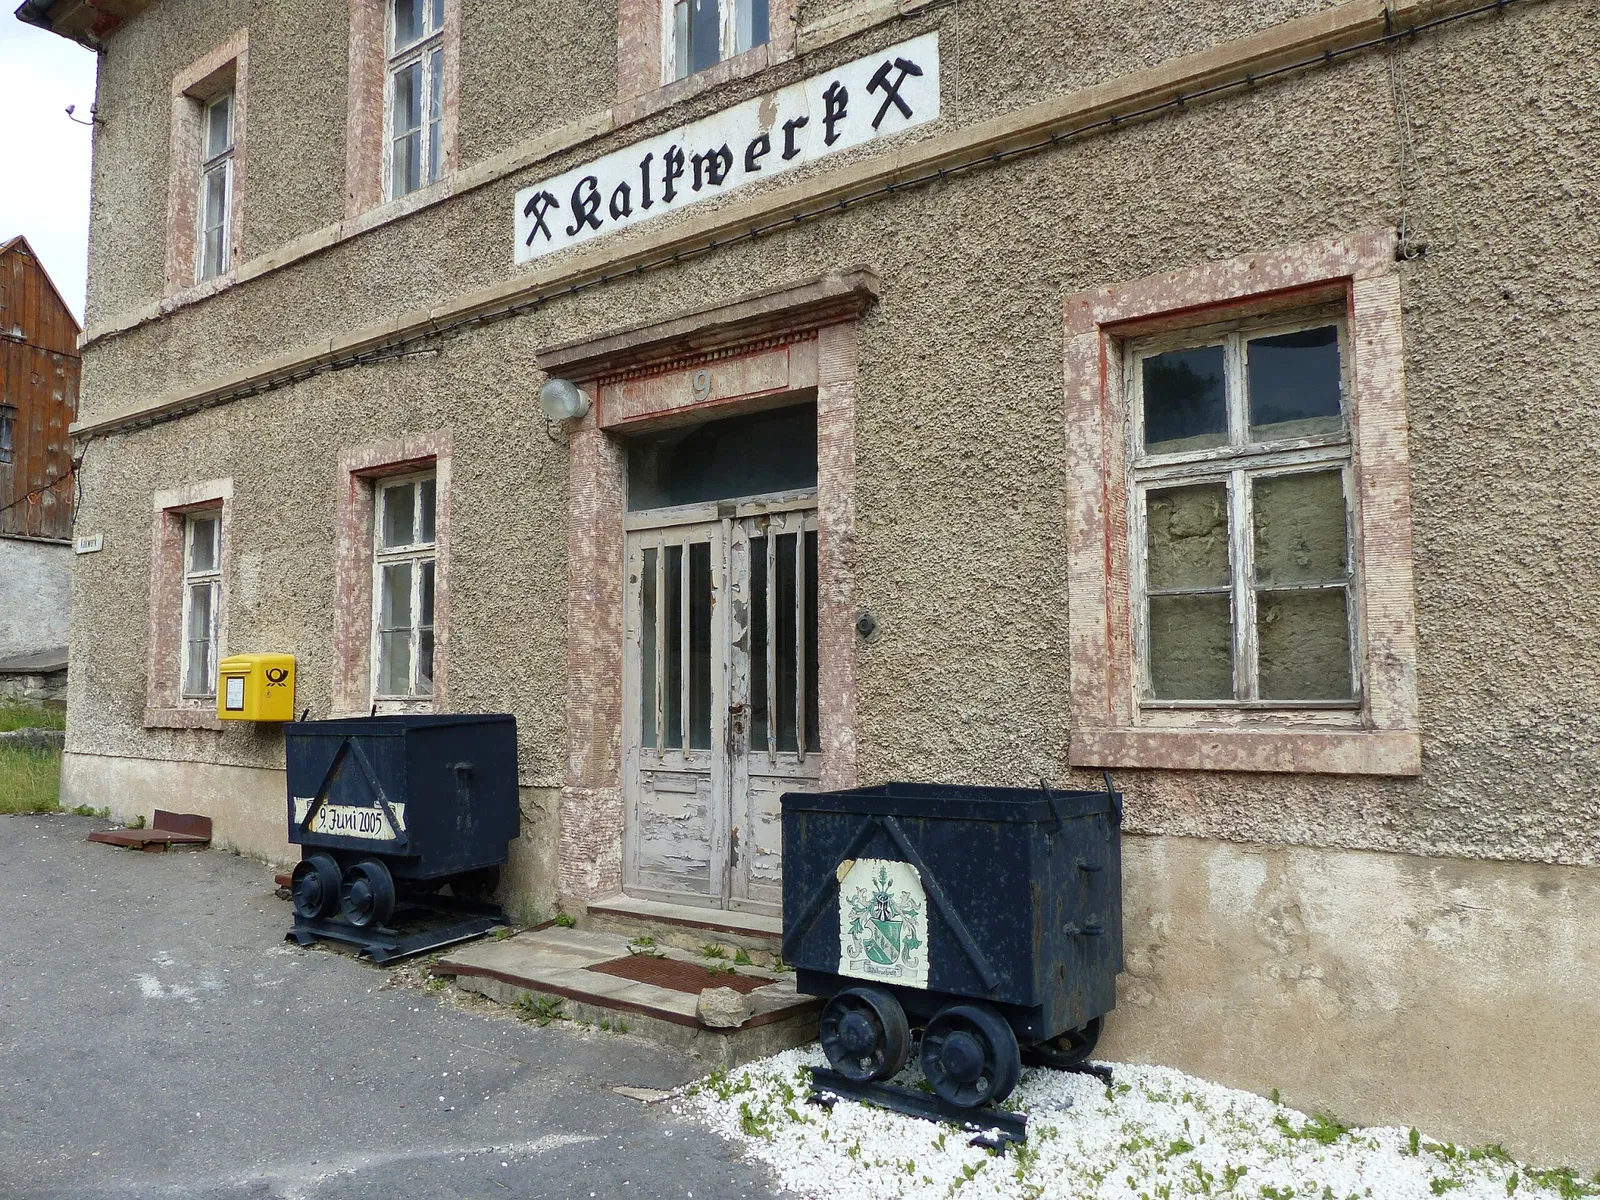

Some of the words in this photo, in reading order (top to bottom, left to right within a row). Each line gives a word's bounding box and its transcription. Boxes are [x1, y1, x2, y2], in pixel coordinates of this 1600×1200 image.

[566, 80, 849, 237] Kalkwerk
[693, 369, 710, 401] 9
[318, 807, 327, 829] 9.
[328, 809, 357, 831] Juni
[358, 811, 382, 836] 2005
